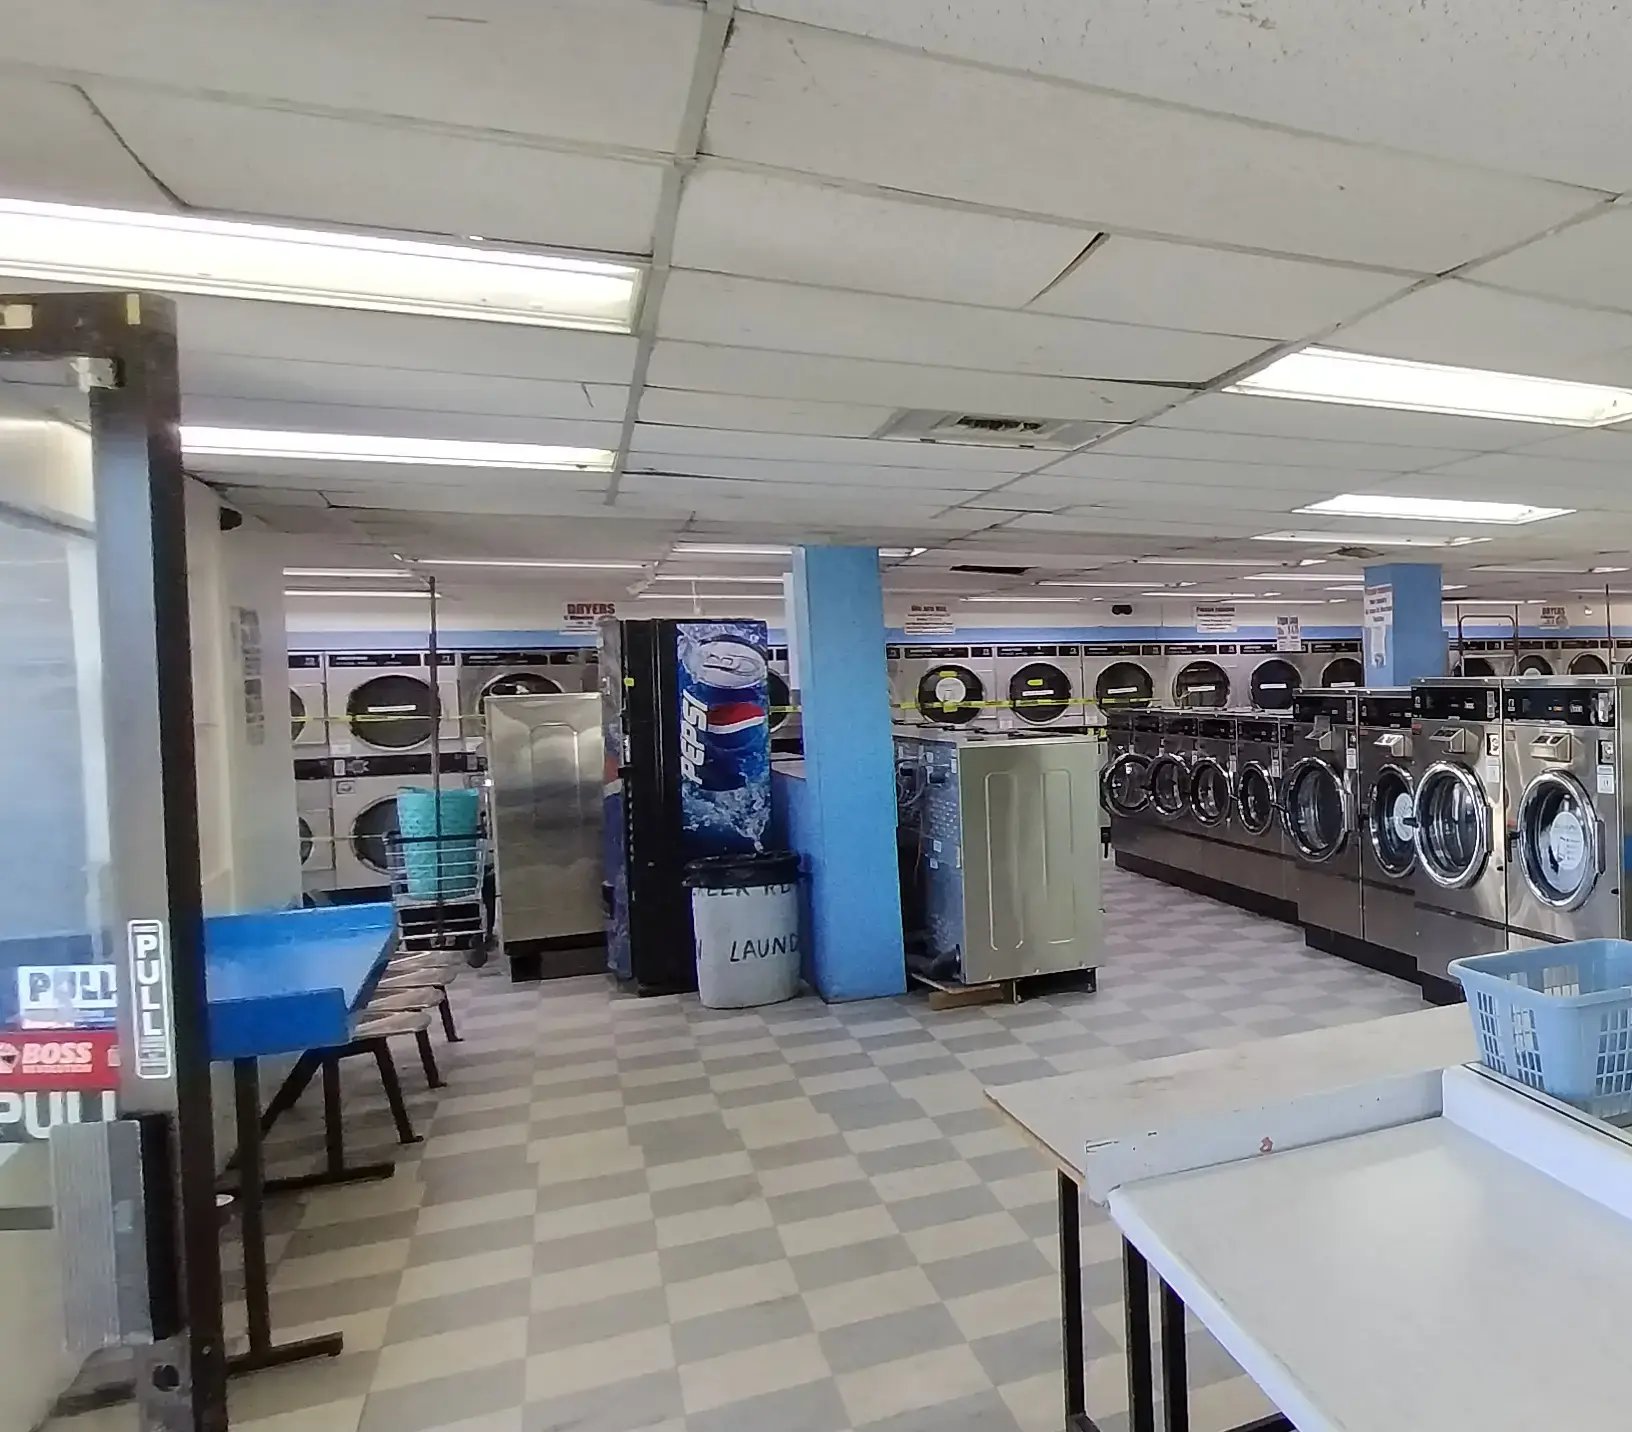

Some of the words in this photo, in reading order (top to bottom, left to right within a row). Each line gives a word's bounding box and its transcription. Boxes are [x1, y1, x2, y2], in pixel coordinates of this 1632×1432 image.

[567, 603, 616, 615] DRYERS
[681, 688, 708, 785] PEPSI
[135, 934, 164, 1036] PULL
[22, 1042, 93, 1064] BOSS
